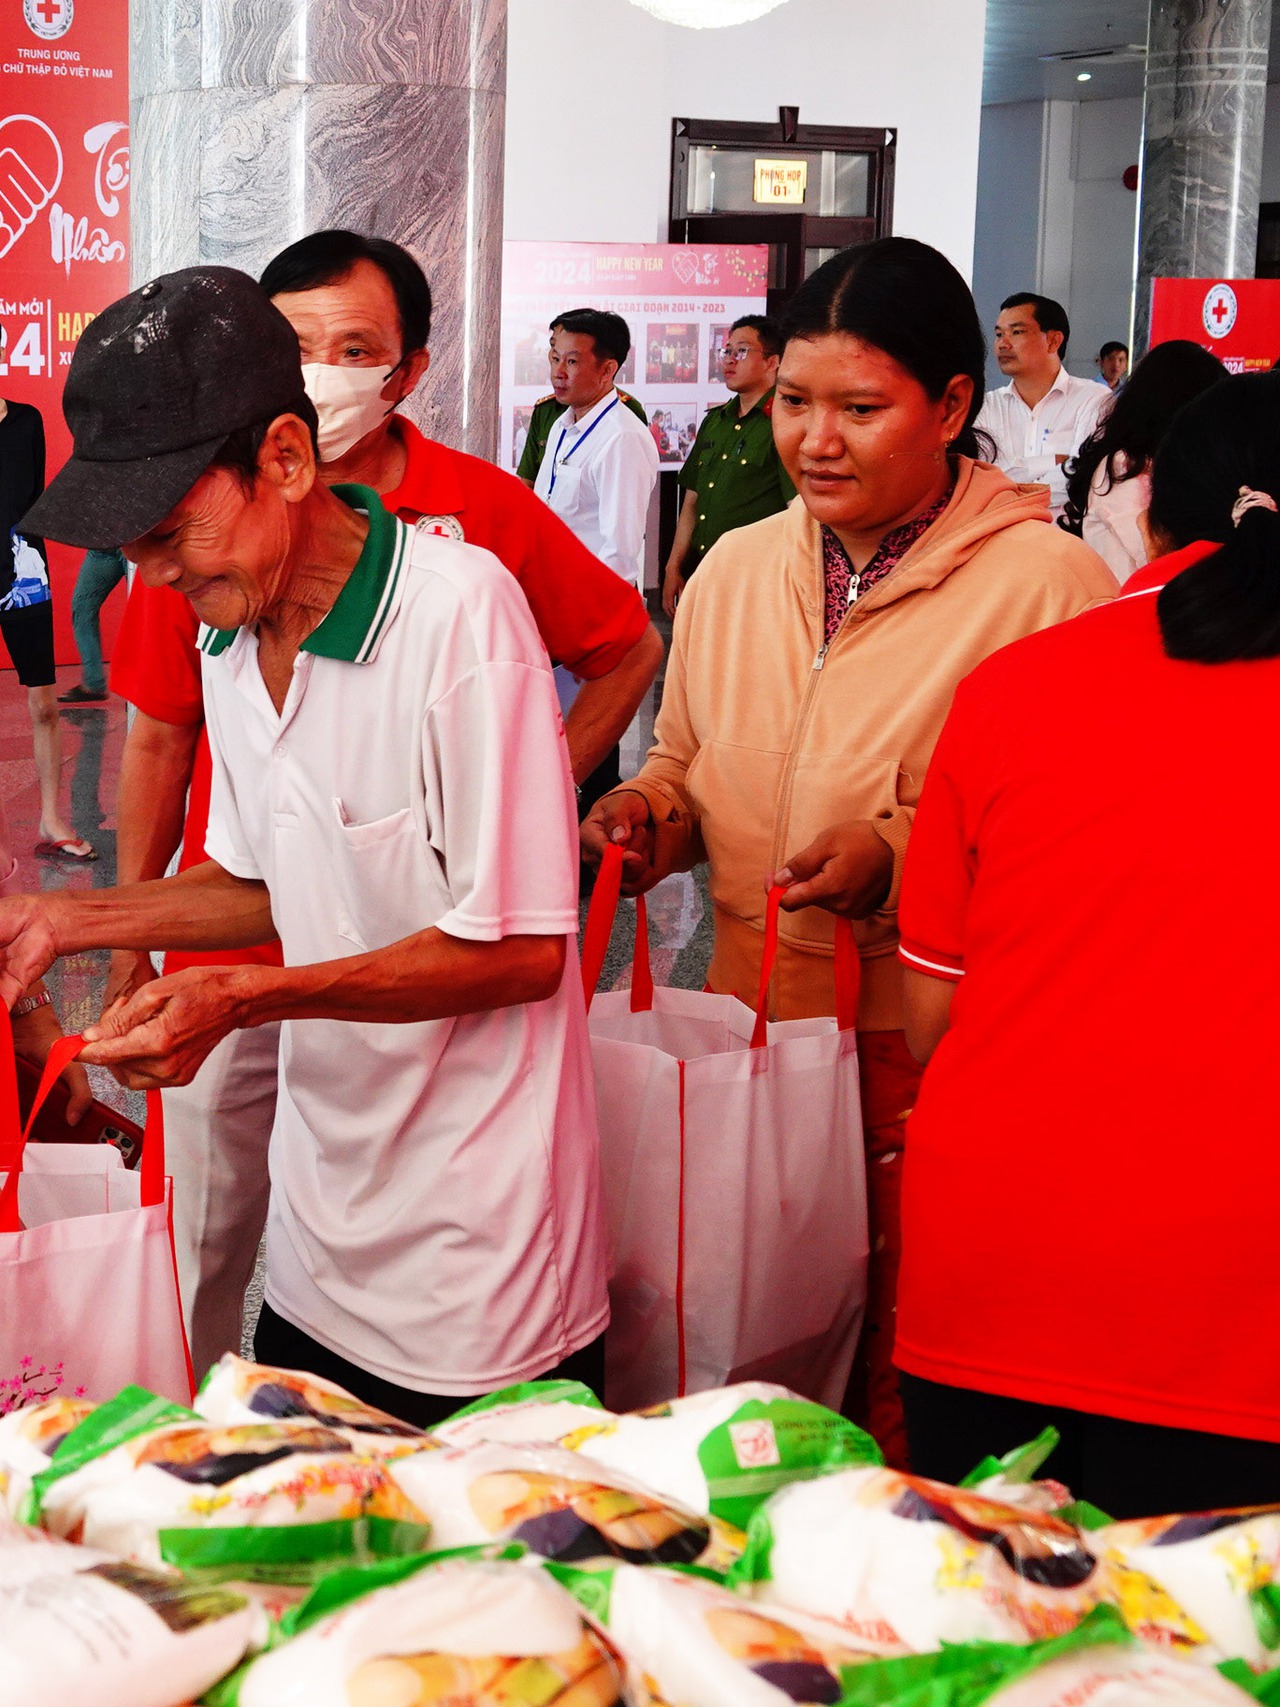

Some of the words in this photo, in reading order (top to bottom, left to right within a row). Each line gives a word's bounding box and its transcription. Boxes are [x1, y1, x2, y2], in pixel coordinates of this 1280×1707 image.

[17, 48, 51, 59] TRUNG
[3, 62, 24, 74] CHỮ
[26, 63, 51, 76] THẬP
[53, 63, 67, 76] ĐỎ
[69, 65, 90, 78] VIỆT
[92, 68, 113, 79] NAM
[773, 185, 787, 197] 01
[534, 259, 591, 285] 2024
[596, 256, 621, 271] HAPPY
[624, 257, 643, 271] NEW
[645, 257, 663, 272] YEAR
[19, 297, 44, 315] MỚI
[671, 303, 694, 313] 2014
[703, 303, 726, 313] 2023
[58, 312, 101, 342] HAP
